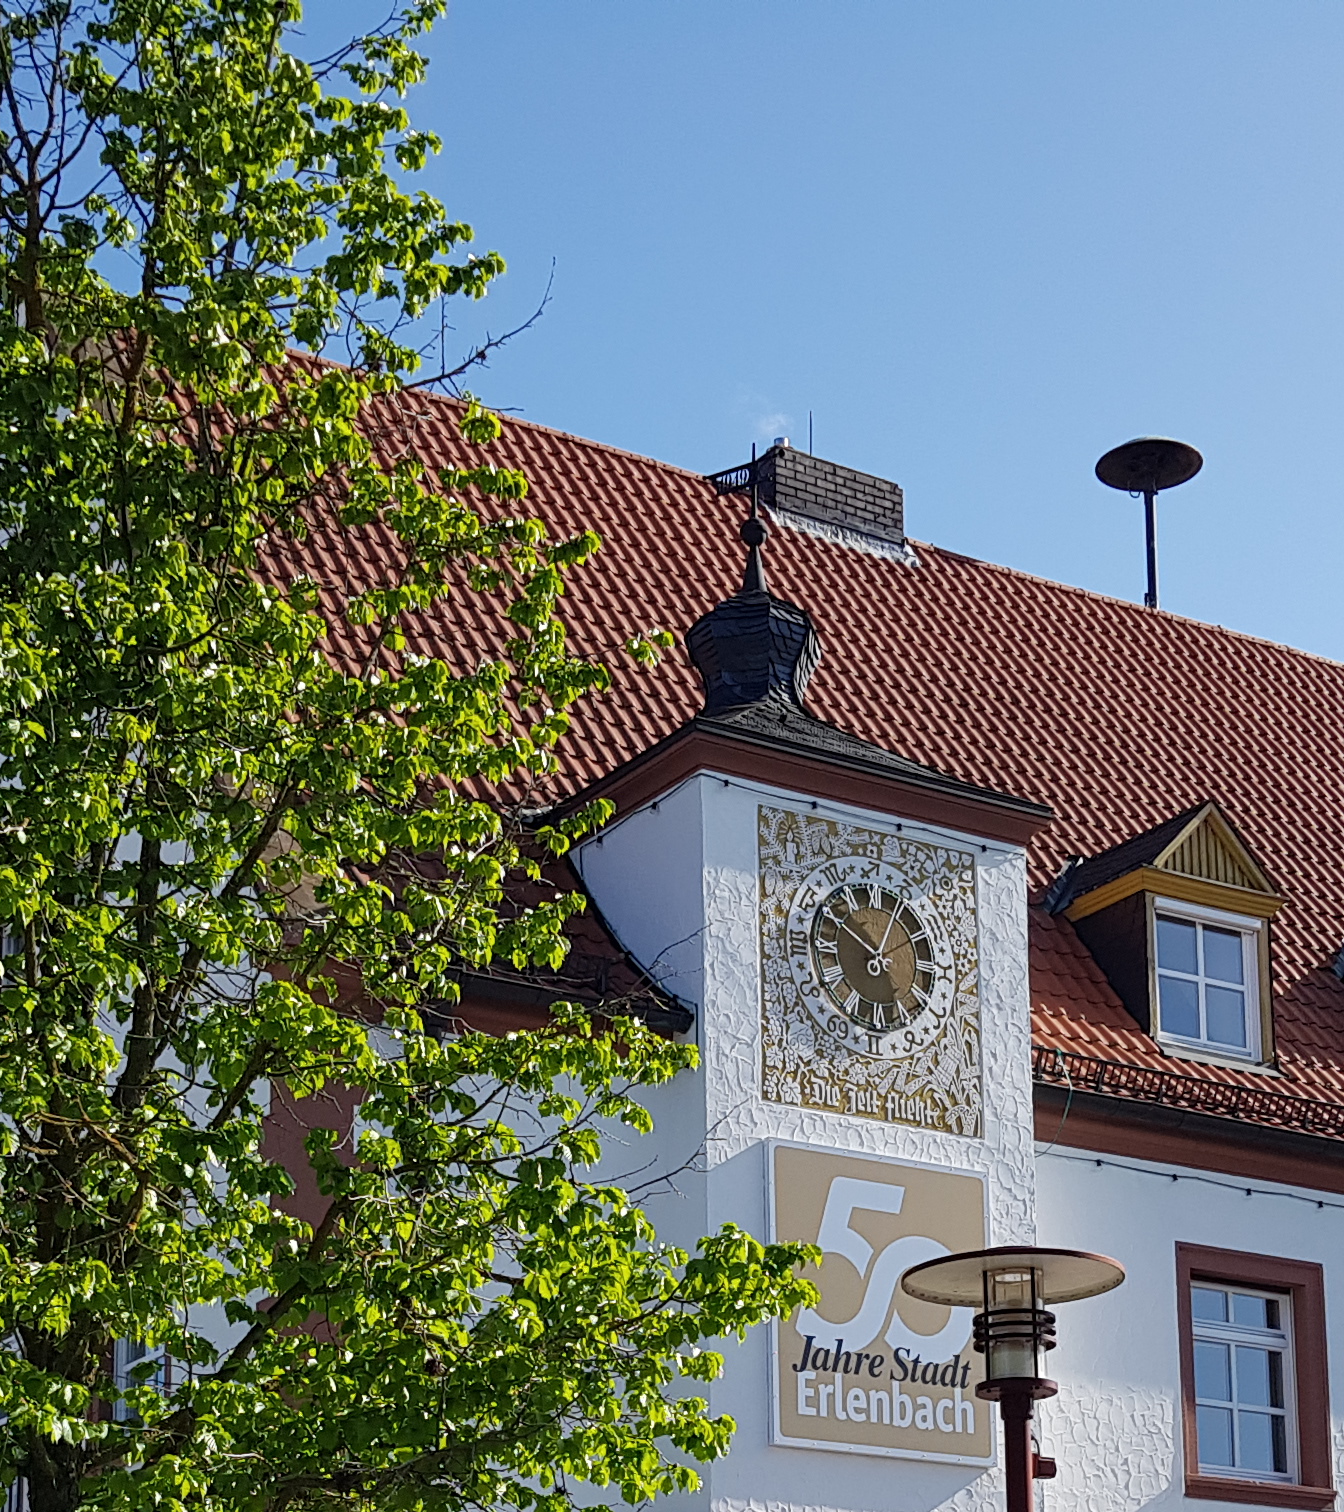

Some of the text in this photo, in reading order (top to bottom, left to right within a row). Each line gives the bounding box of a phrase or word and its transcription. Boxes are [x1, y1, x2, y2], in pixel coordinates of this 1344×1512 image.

[809, 1075, 841, 1107] Die
[795, 1176, 975, 1364] 50
[792, 1334, 972, 1390] Jahre Stadt
[796, 1370, 975, 1434] Erlenbach
